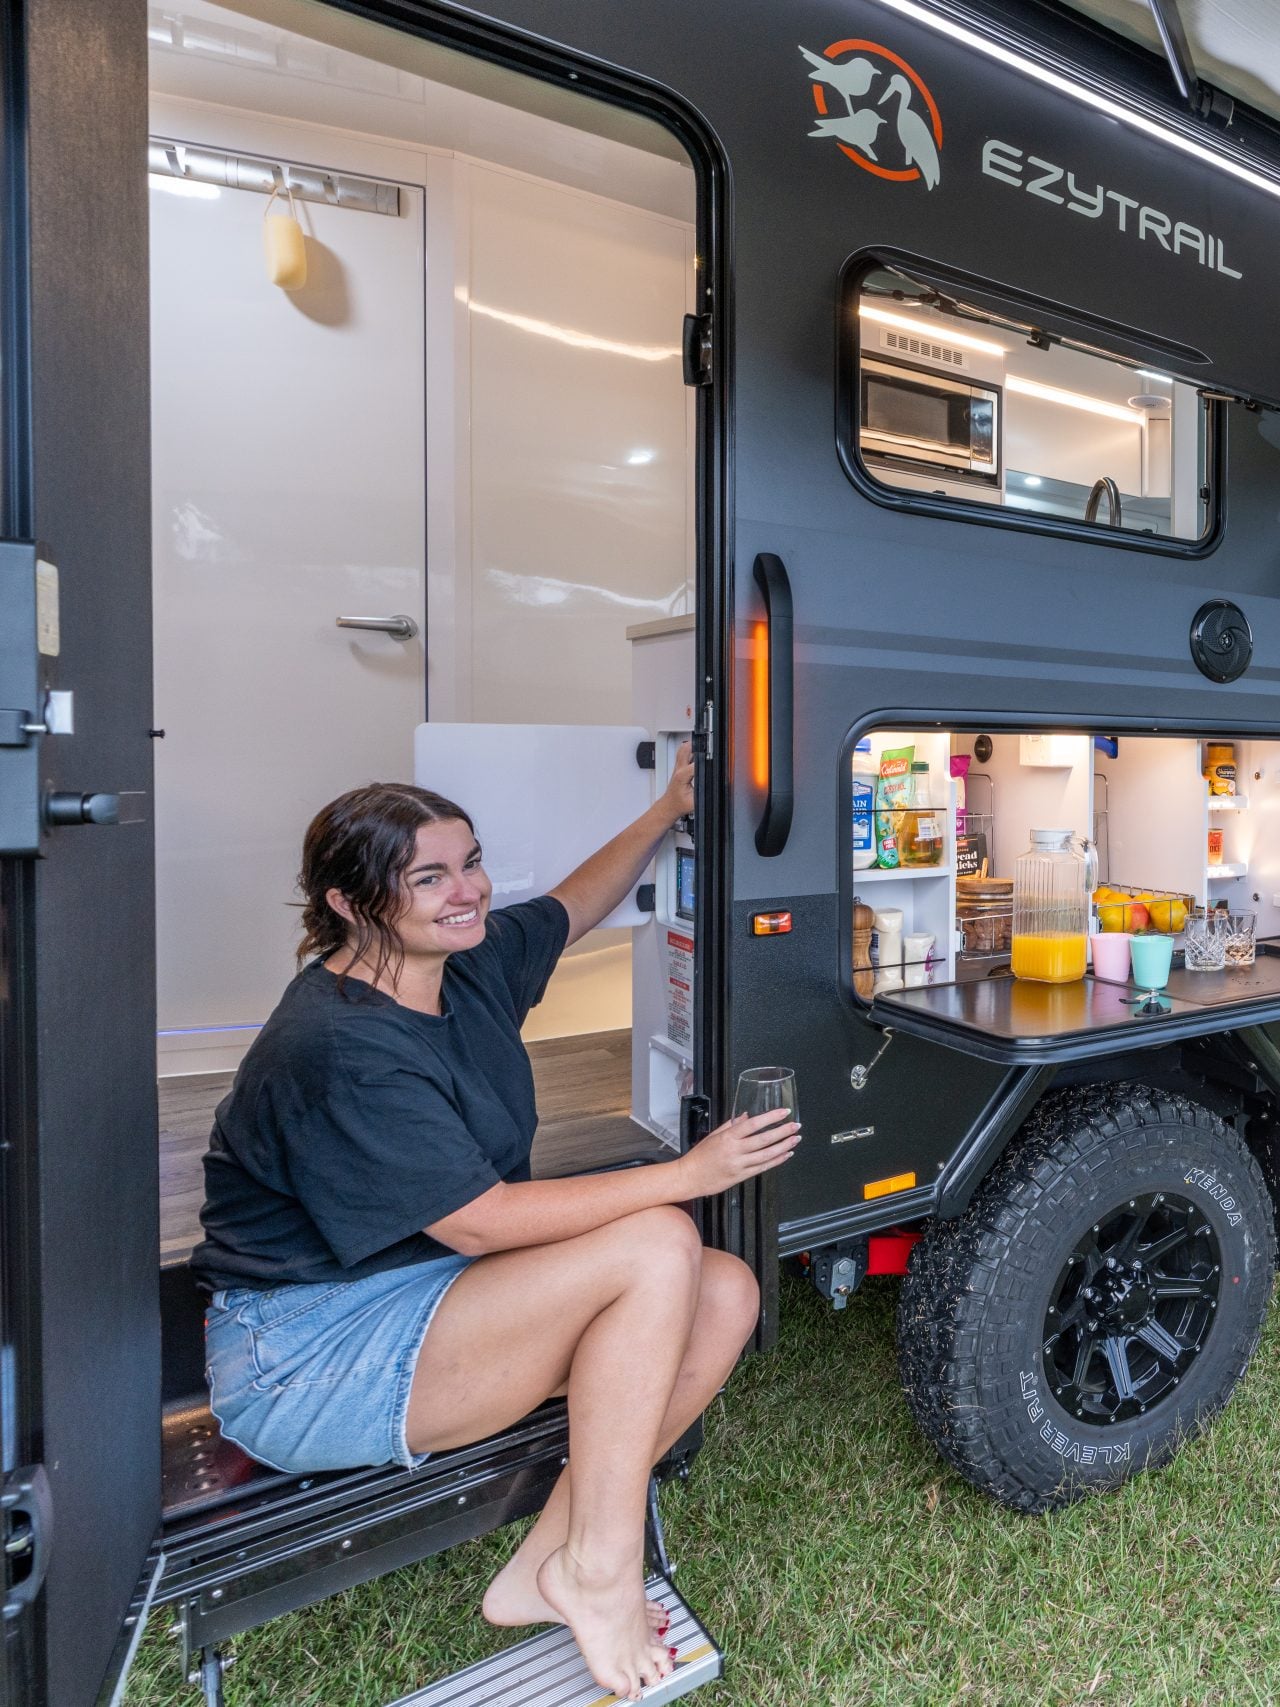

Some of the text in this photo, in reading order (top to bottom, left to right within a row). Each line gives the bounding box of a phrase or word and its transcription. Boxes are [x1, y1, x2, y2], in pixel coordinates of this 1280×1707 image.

[982, 140, 1242, 279] EZYTRAIL
[1184, 1168, 1242, 1227] KENDA
[1040, 1419, 1130, 1464] KLEVER
